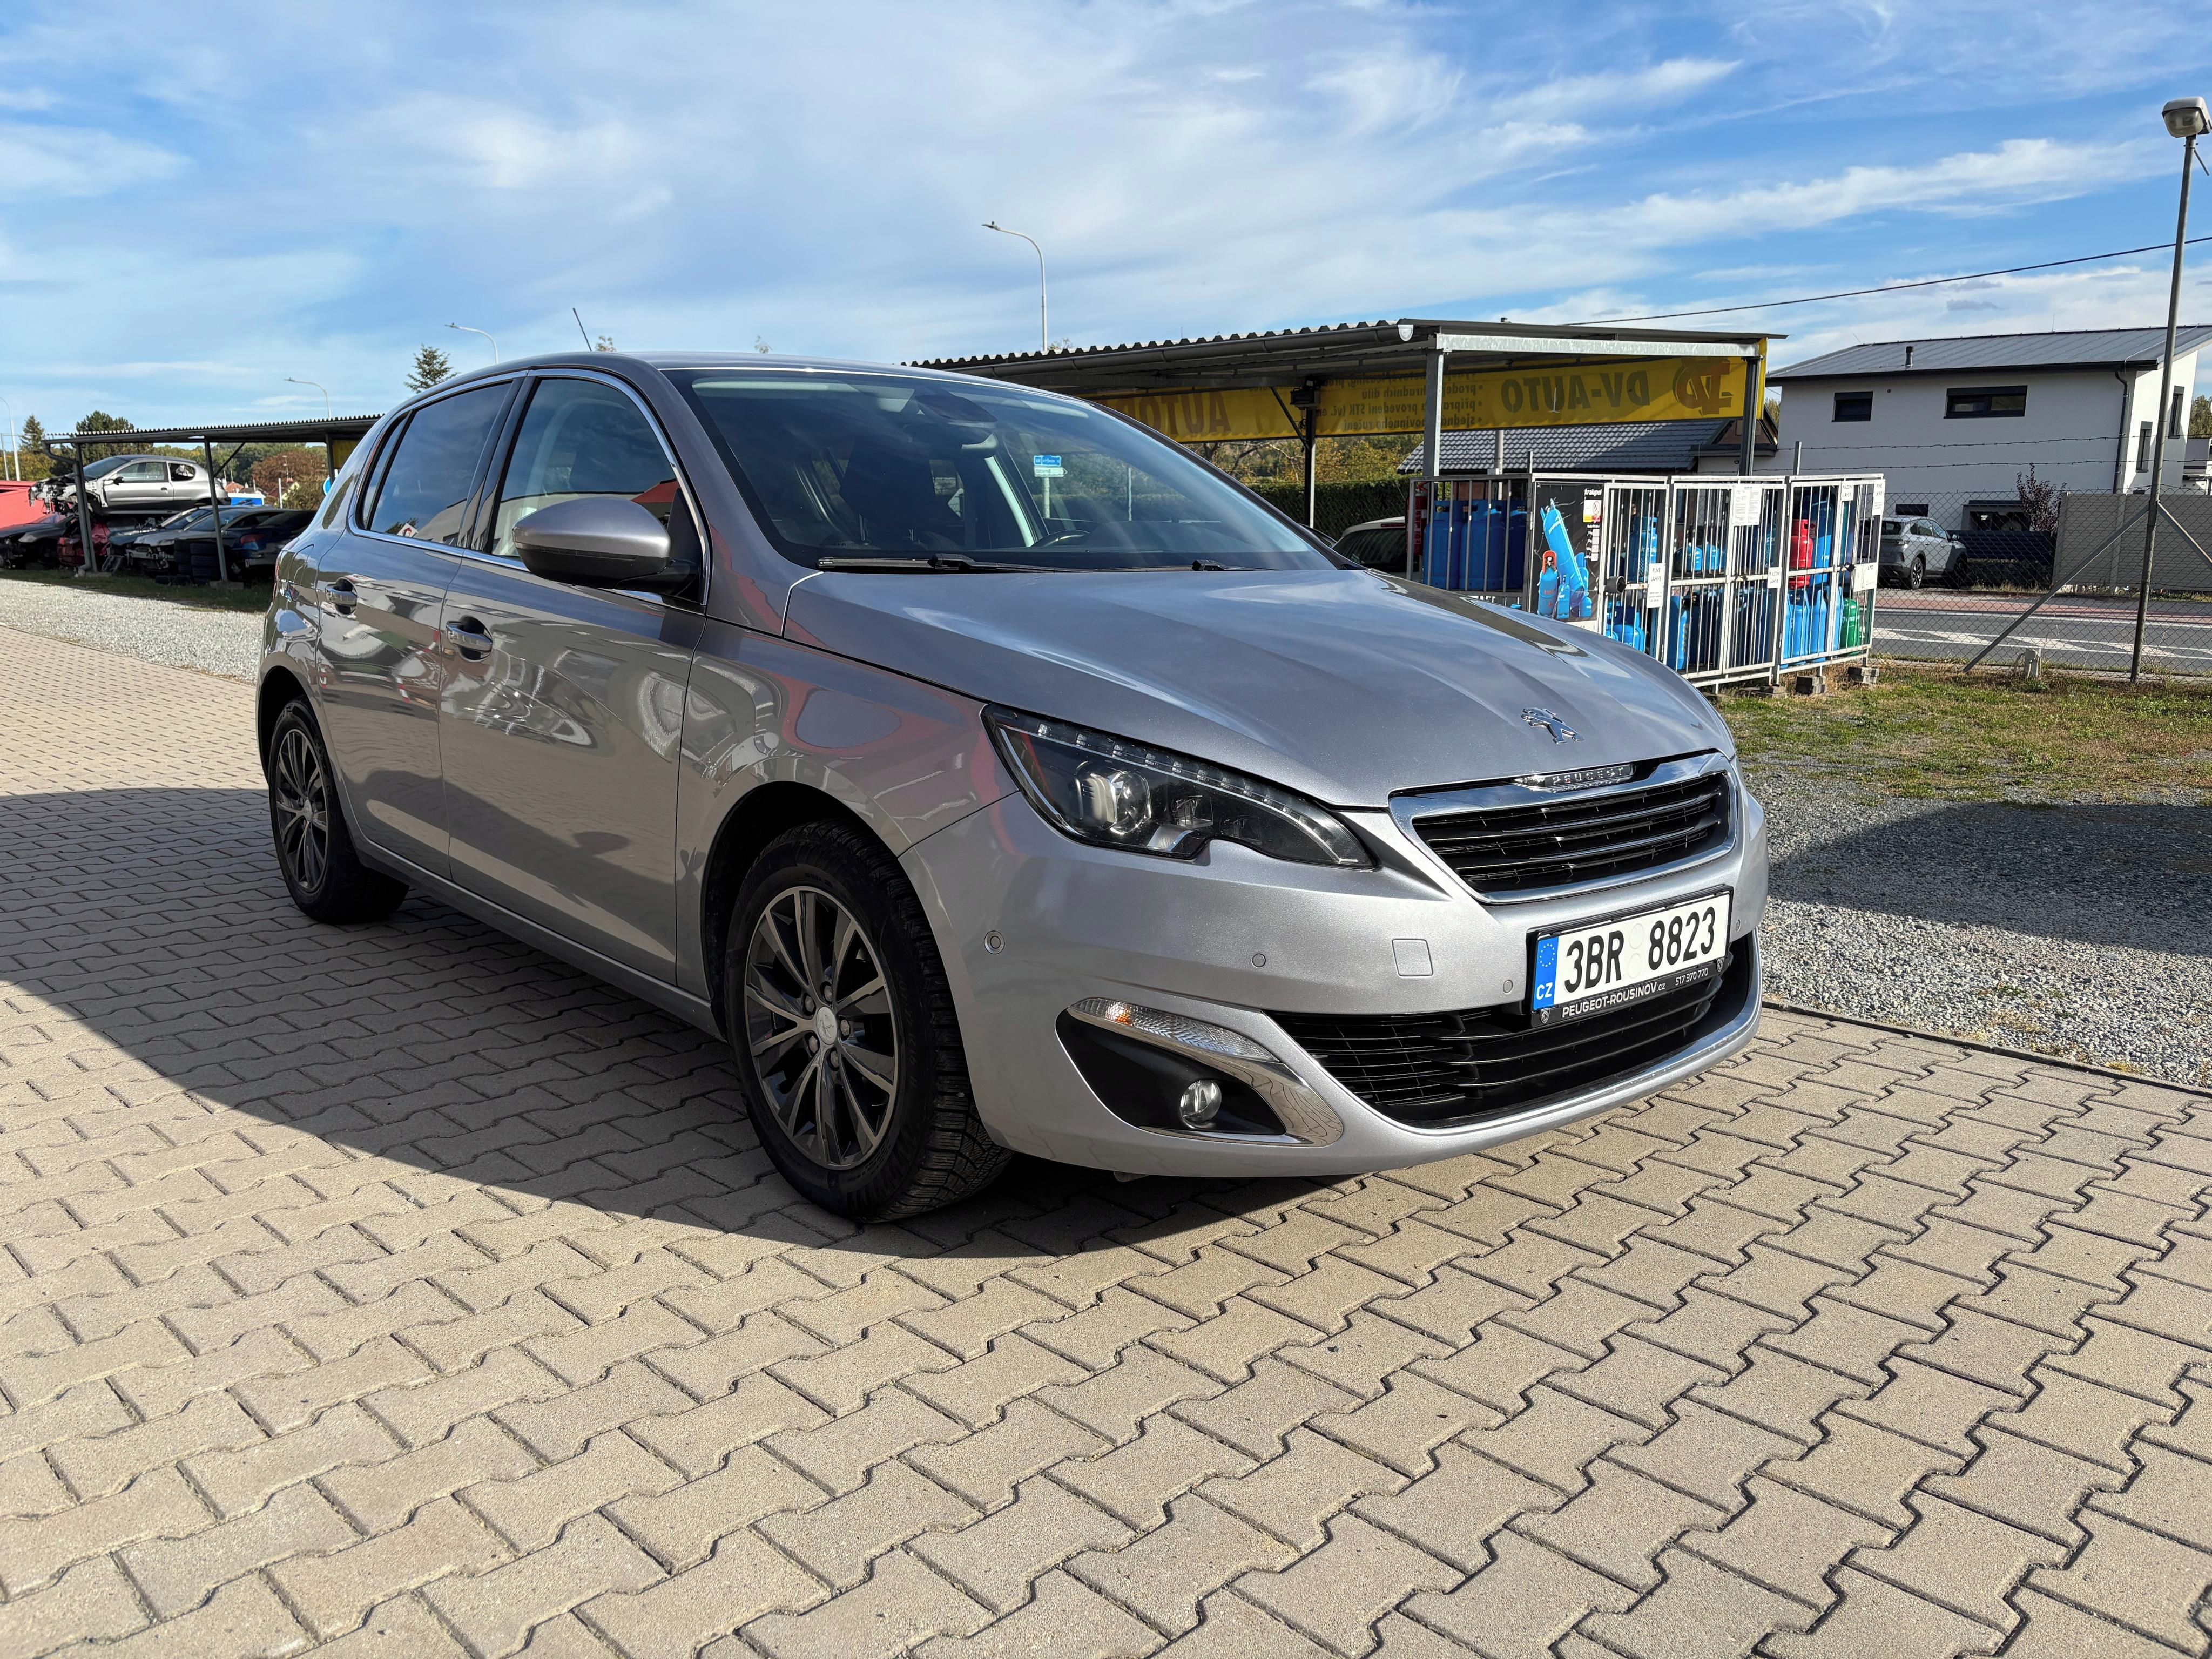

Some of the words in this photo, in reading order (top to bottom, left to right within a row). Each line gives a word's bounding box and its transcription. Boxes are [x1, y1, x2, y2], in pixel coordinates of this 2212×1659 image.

[1564, 930, 1624, 993] 3BR
[1648, 906, 1716, 971] 8823
[1536, 981, 1554, 1000] CZ
[1561, 982, 1666, 1019] PEUGEOT-ROUSINOV.cz
[1675, 975, 1685, 986] 517
[1685, 971, 1697, 982] 370
[1698, 968, 1708, 978] 770
